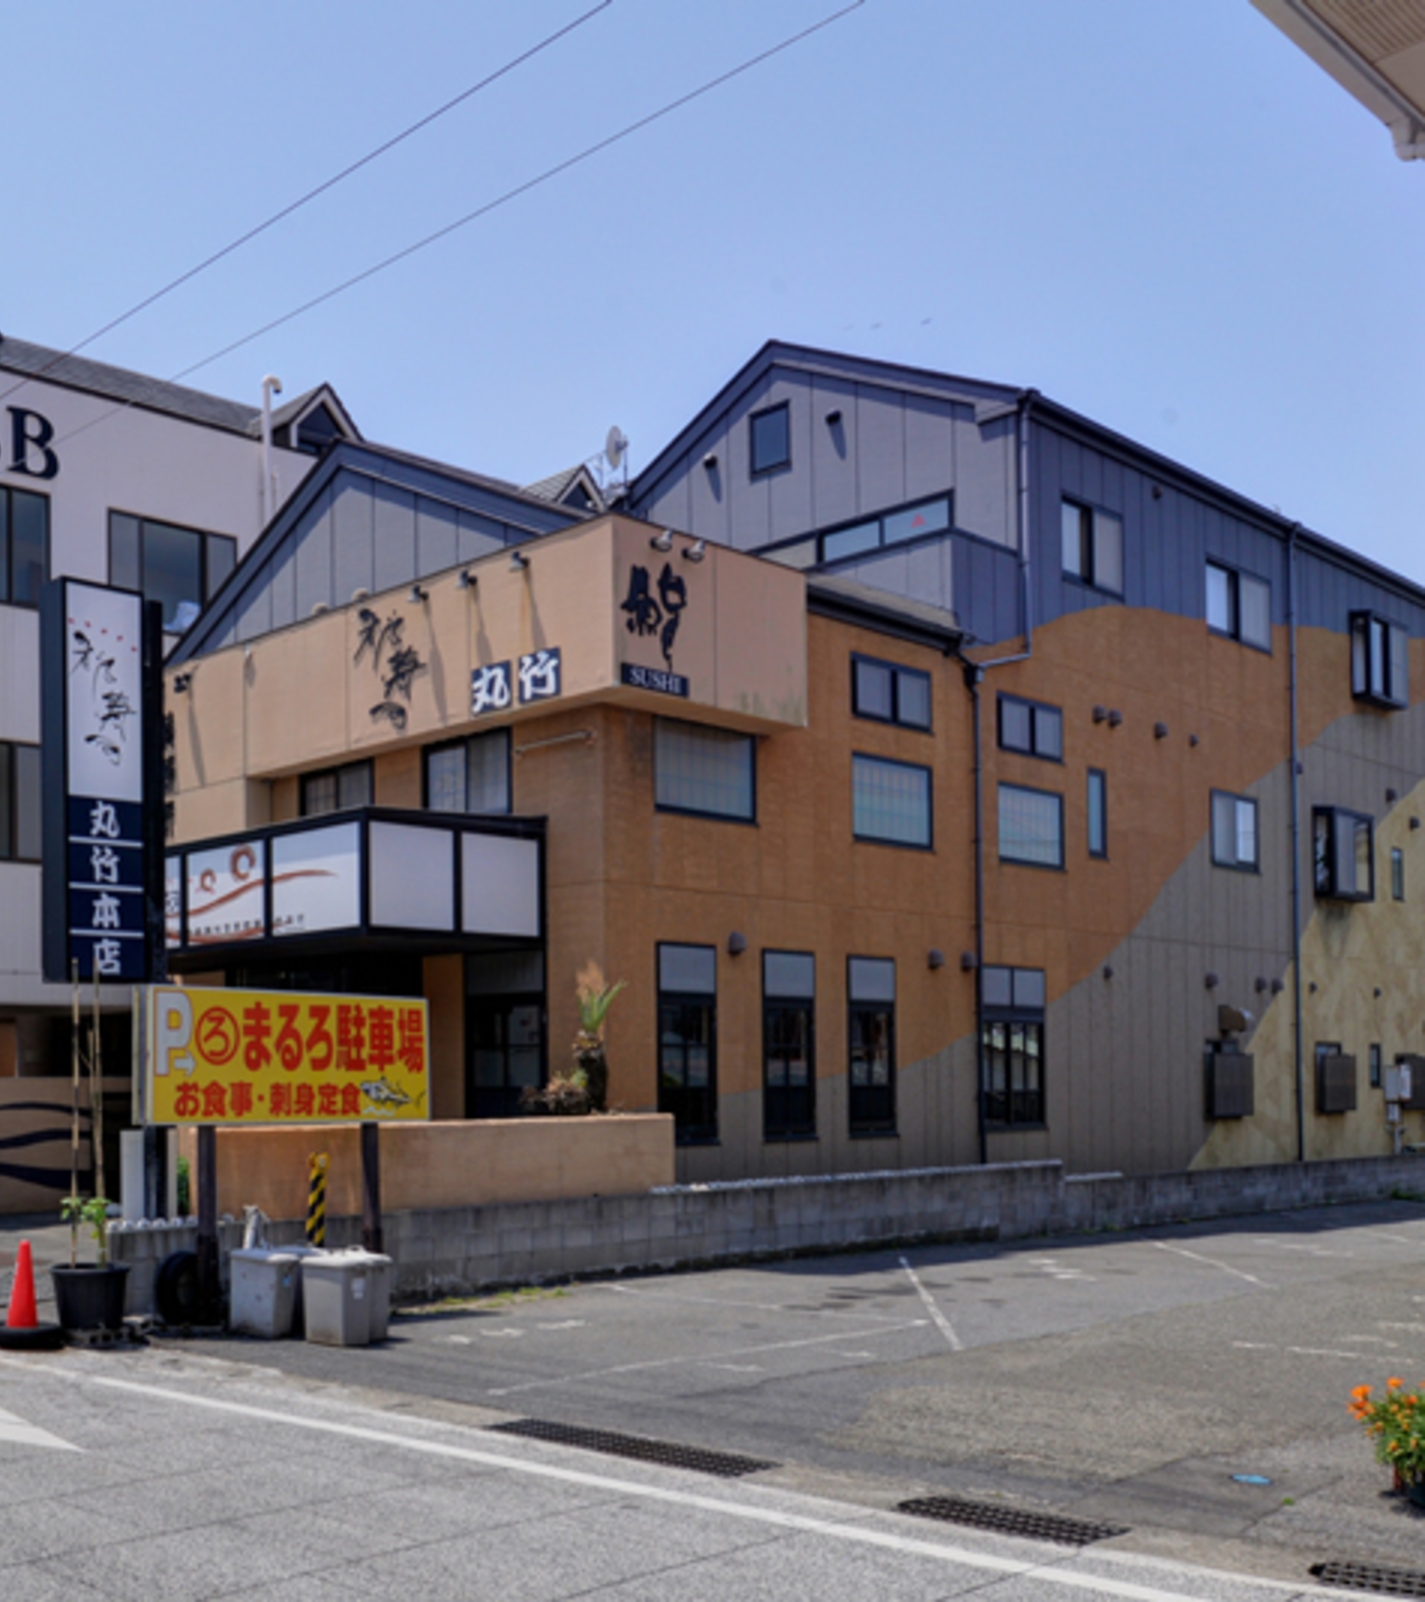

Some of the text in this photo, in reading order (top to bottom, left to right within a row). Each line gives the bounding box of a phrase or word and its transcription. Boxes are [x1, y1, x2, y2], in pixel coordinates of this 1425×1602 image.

[472, 651, 559, 715] 丸竹
[629, 666, 682, 695] SUSHI
[90, 801, 121, 976] 丸竹本店
[154, 990, 192, 1077] P
[241, 1001, 425, 1074] まるろ駐車場
[174, 1080, 362, 1118] お食事・刺身定食
